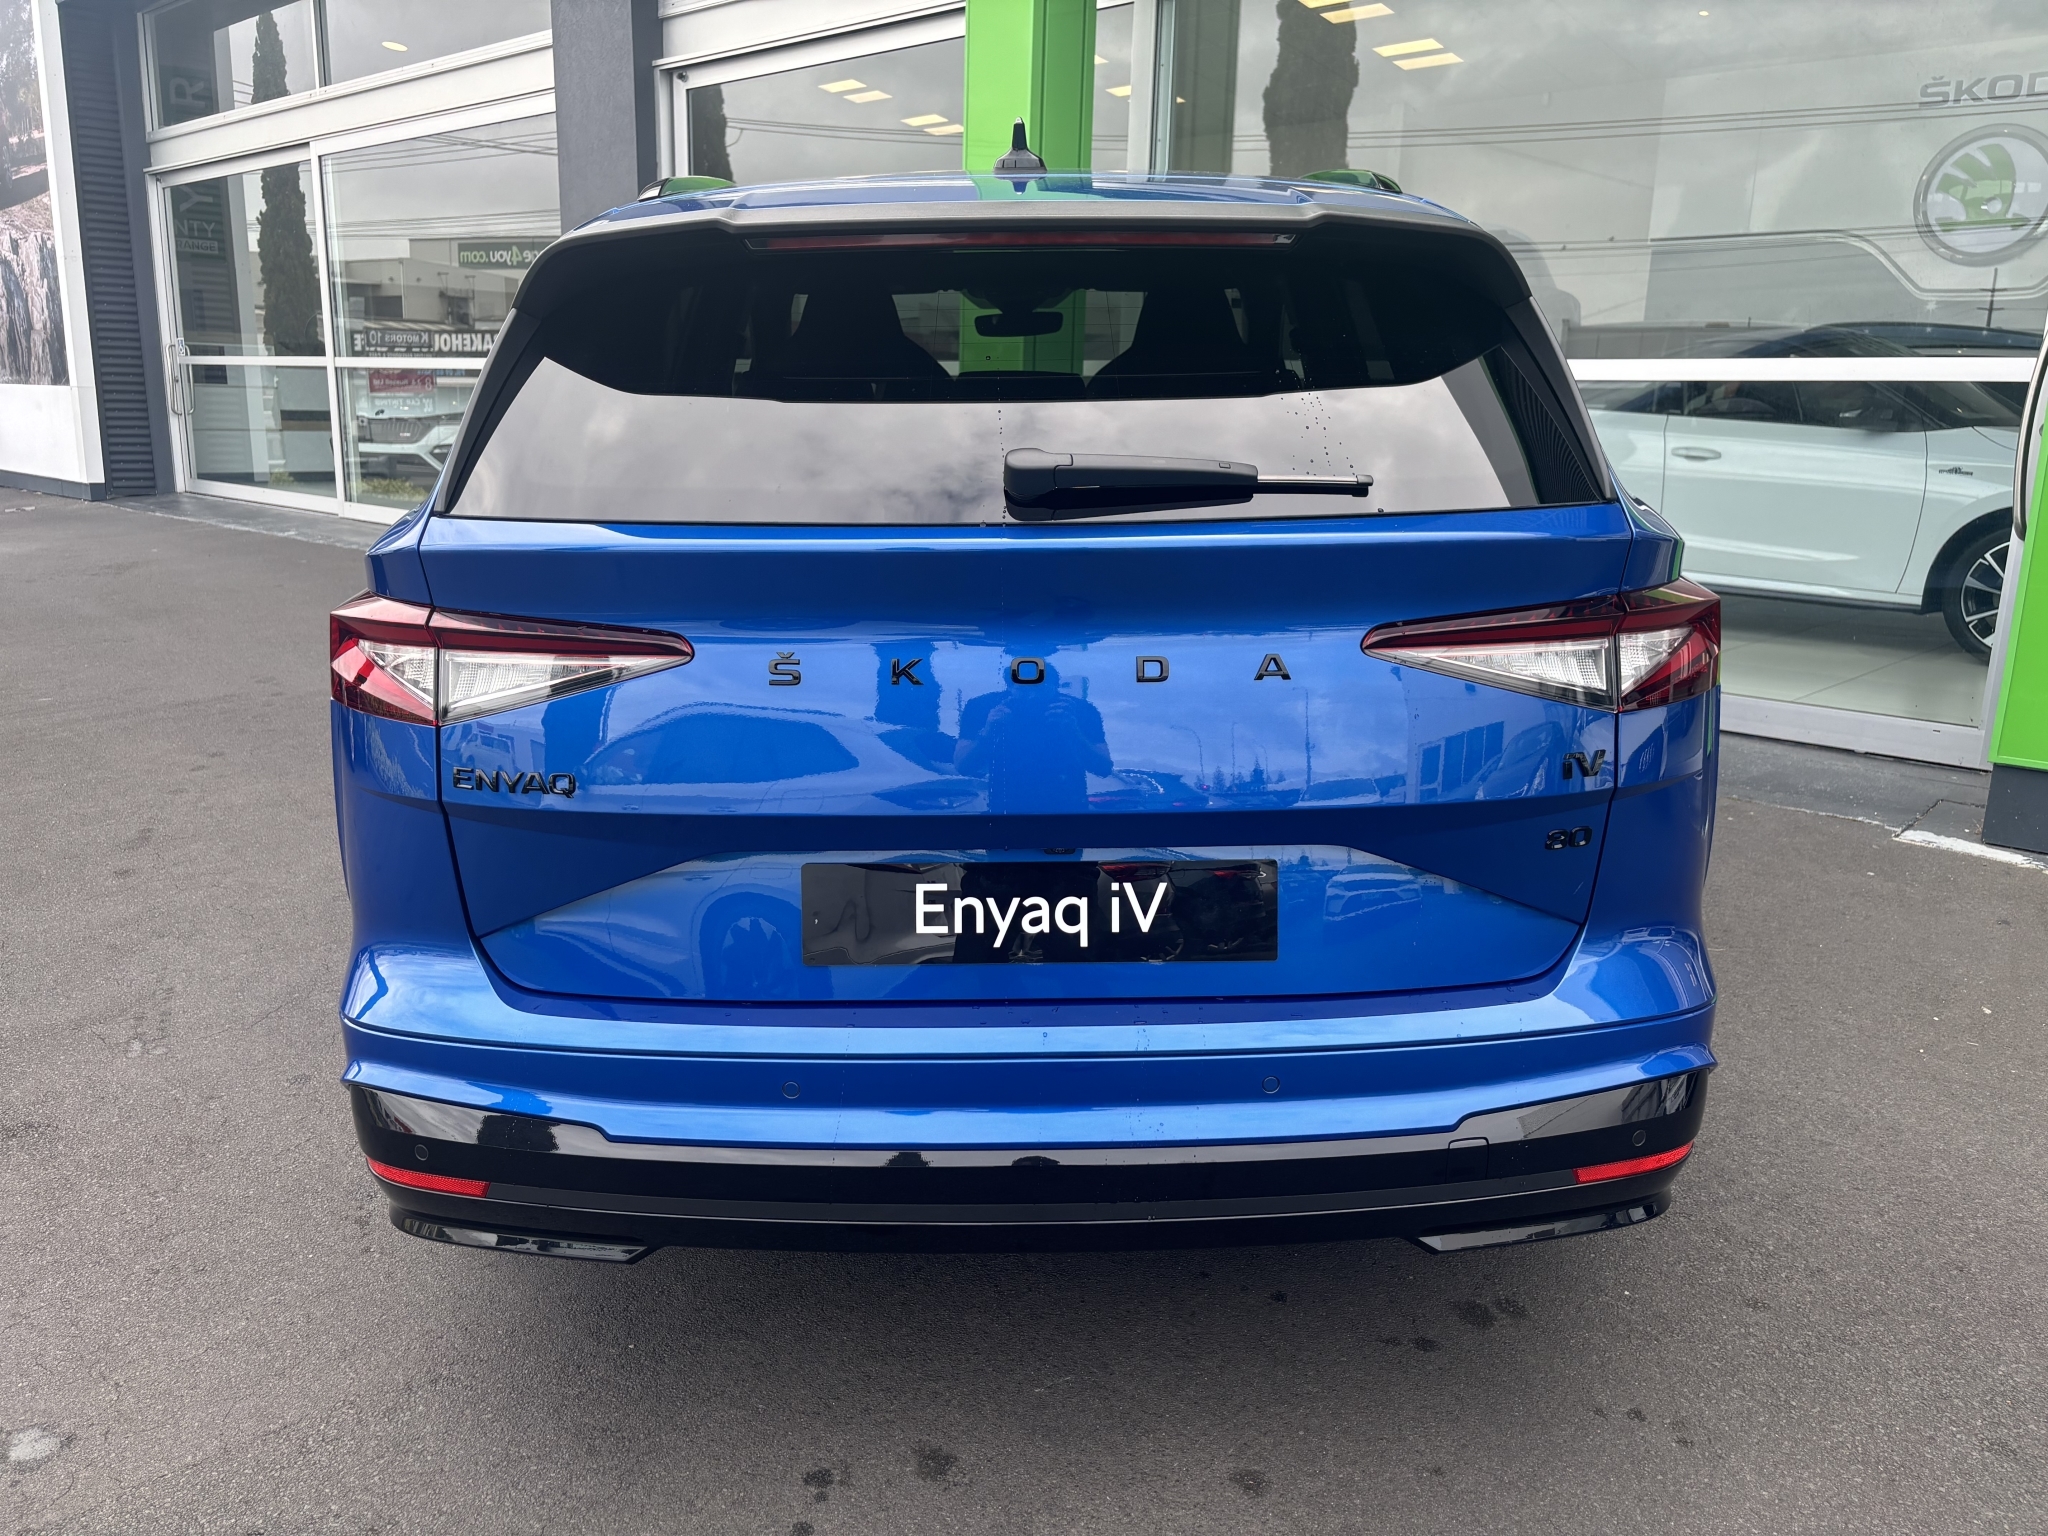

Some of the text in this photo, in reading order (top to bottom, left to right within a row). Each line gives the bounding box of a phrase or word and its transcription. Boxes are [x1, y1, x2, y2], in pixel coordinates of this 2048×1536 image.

[768, 651, 1292, 686] ŠKODA
[453, 766, 577, 799] ENYAQ
[1545, 825, 1593, 850] 80
[915, 882, 1168, 948] Enyaq iV
